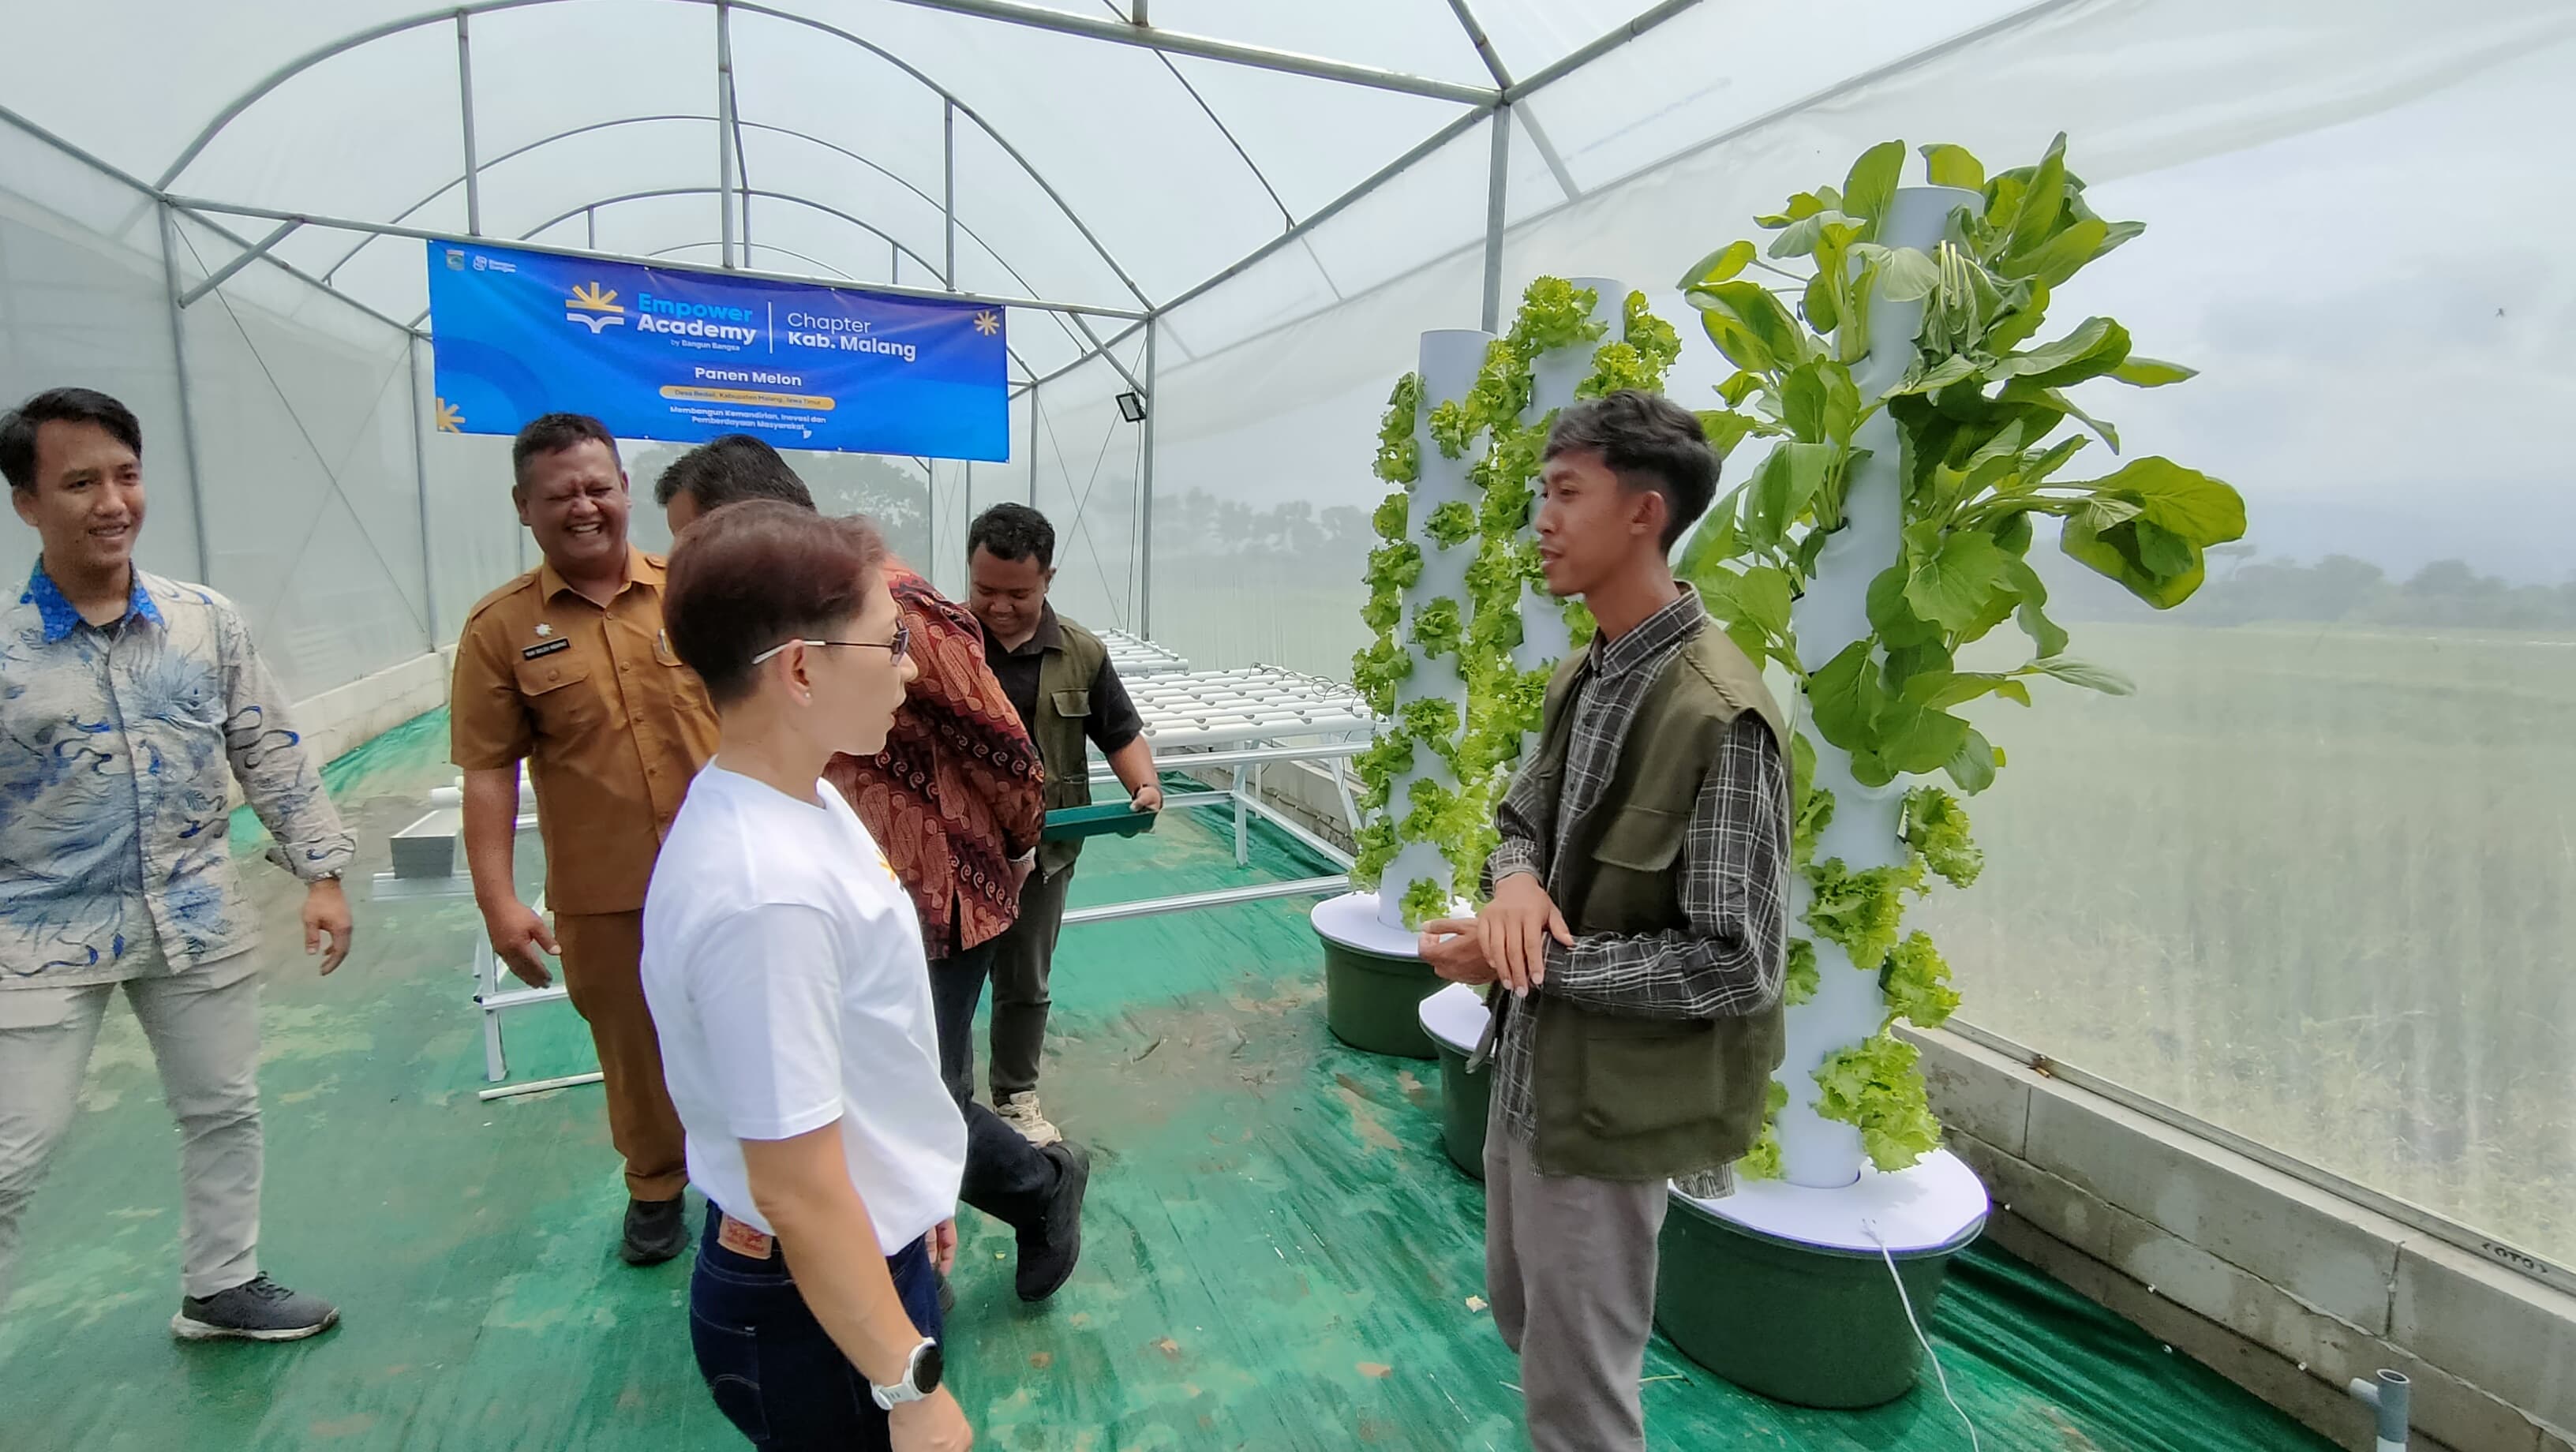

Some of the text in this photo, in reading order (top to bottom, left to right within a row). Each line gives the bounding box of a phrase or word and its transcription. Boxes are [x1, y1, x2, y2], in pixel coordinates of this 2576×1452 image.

[638, 293, 754, 322] Empower
[637, 314, 757, 345] Academy
[788, 312, 871, 335] Chapter
[788, 331, 916, 362] Kab. Malang
[695, 367, 802, 386] Panen Melon
[669, 406, 724, 417] Membangun
[691, 416, 756, 428] Pemberdayaan
